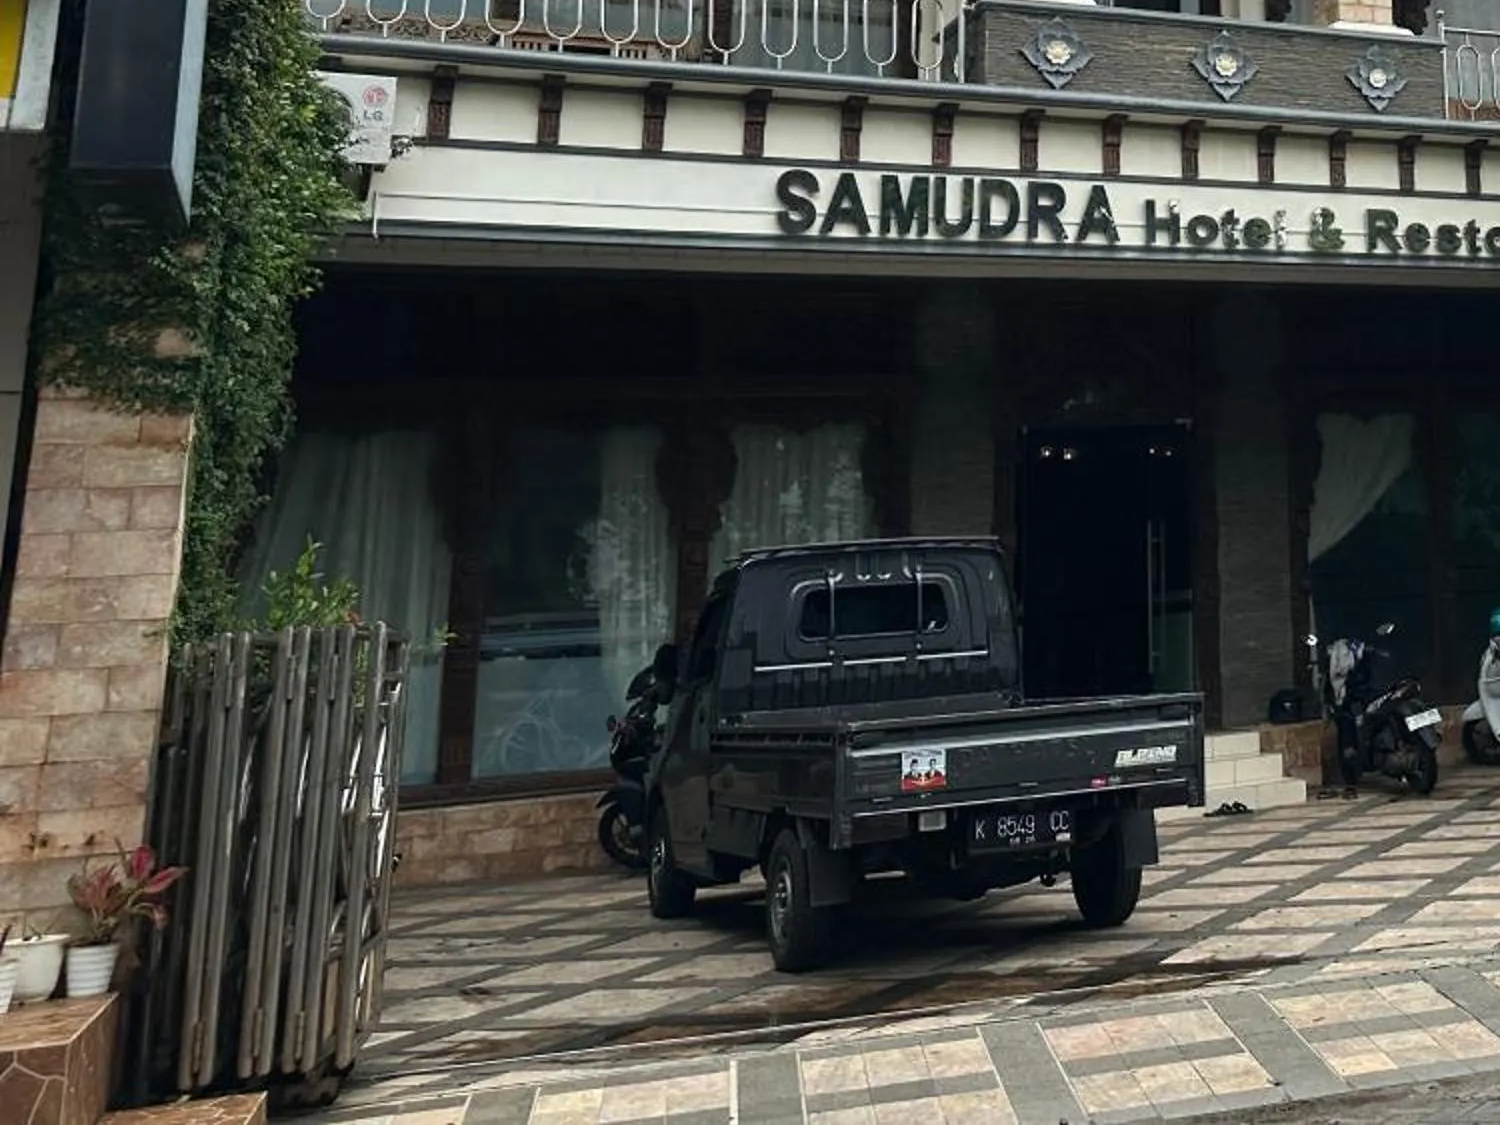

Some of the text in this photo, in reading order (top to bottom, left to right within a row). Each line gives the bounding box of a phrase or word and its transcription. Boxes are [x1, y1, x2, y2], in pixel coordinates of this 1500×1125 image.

[363, 110, 384, 122] LG
[775, 169, 1121, 244] SAMUDRA
[1143, 198, 1287, 251] Hotel
[1308, 206, 1346, 251] &
[975, 819, 986, 840] K
